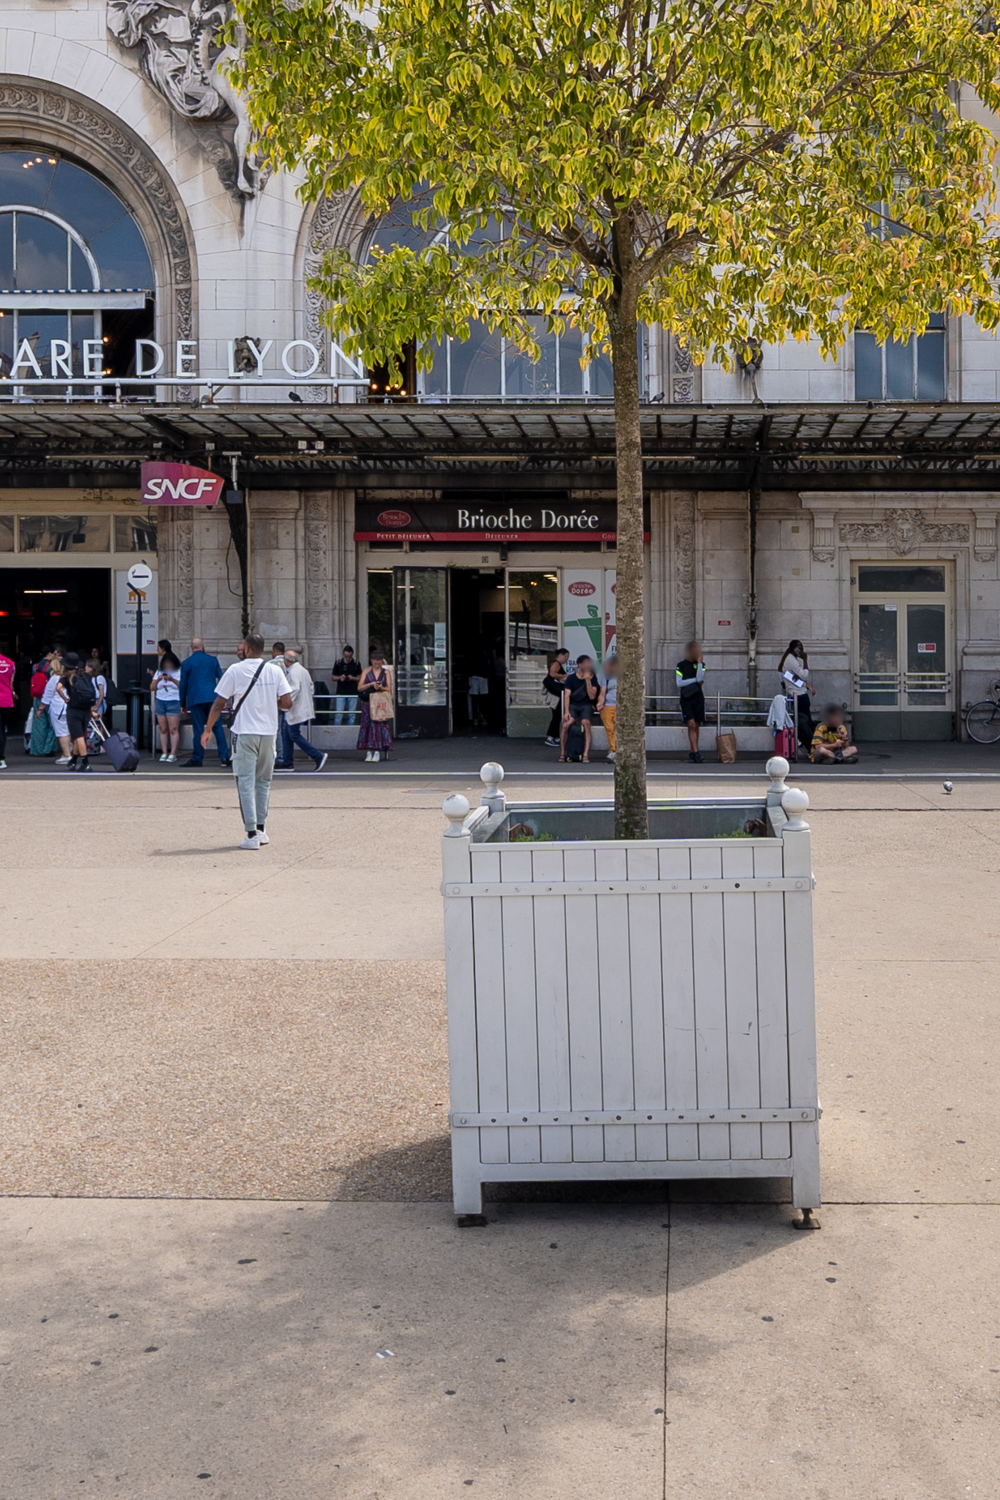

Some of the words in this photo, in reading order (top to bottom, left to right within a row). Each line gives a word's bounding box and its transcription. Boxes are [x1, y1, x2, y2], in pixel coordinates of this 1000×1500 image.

[136, 339, 197, 378] DE
[228, 339, 364, 379] LYON
[145, 478, 217, 500] SNCF
[457, 508, 532, 529] Brioche
[541, 509, 599, 529] Dorée
